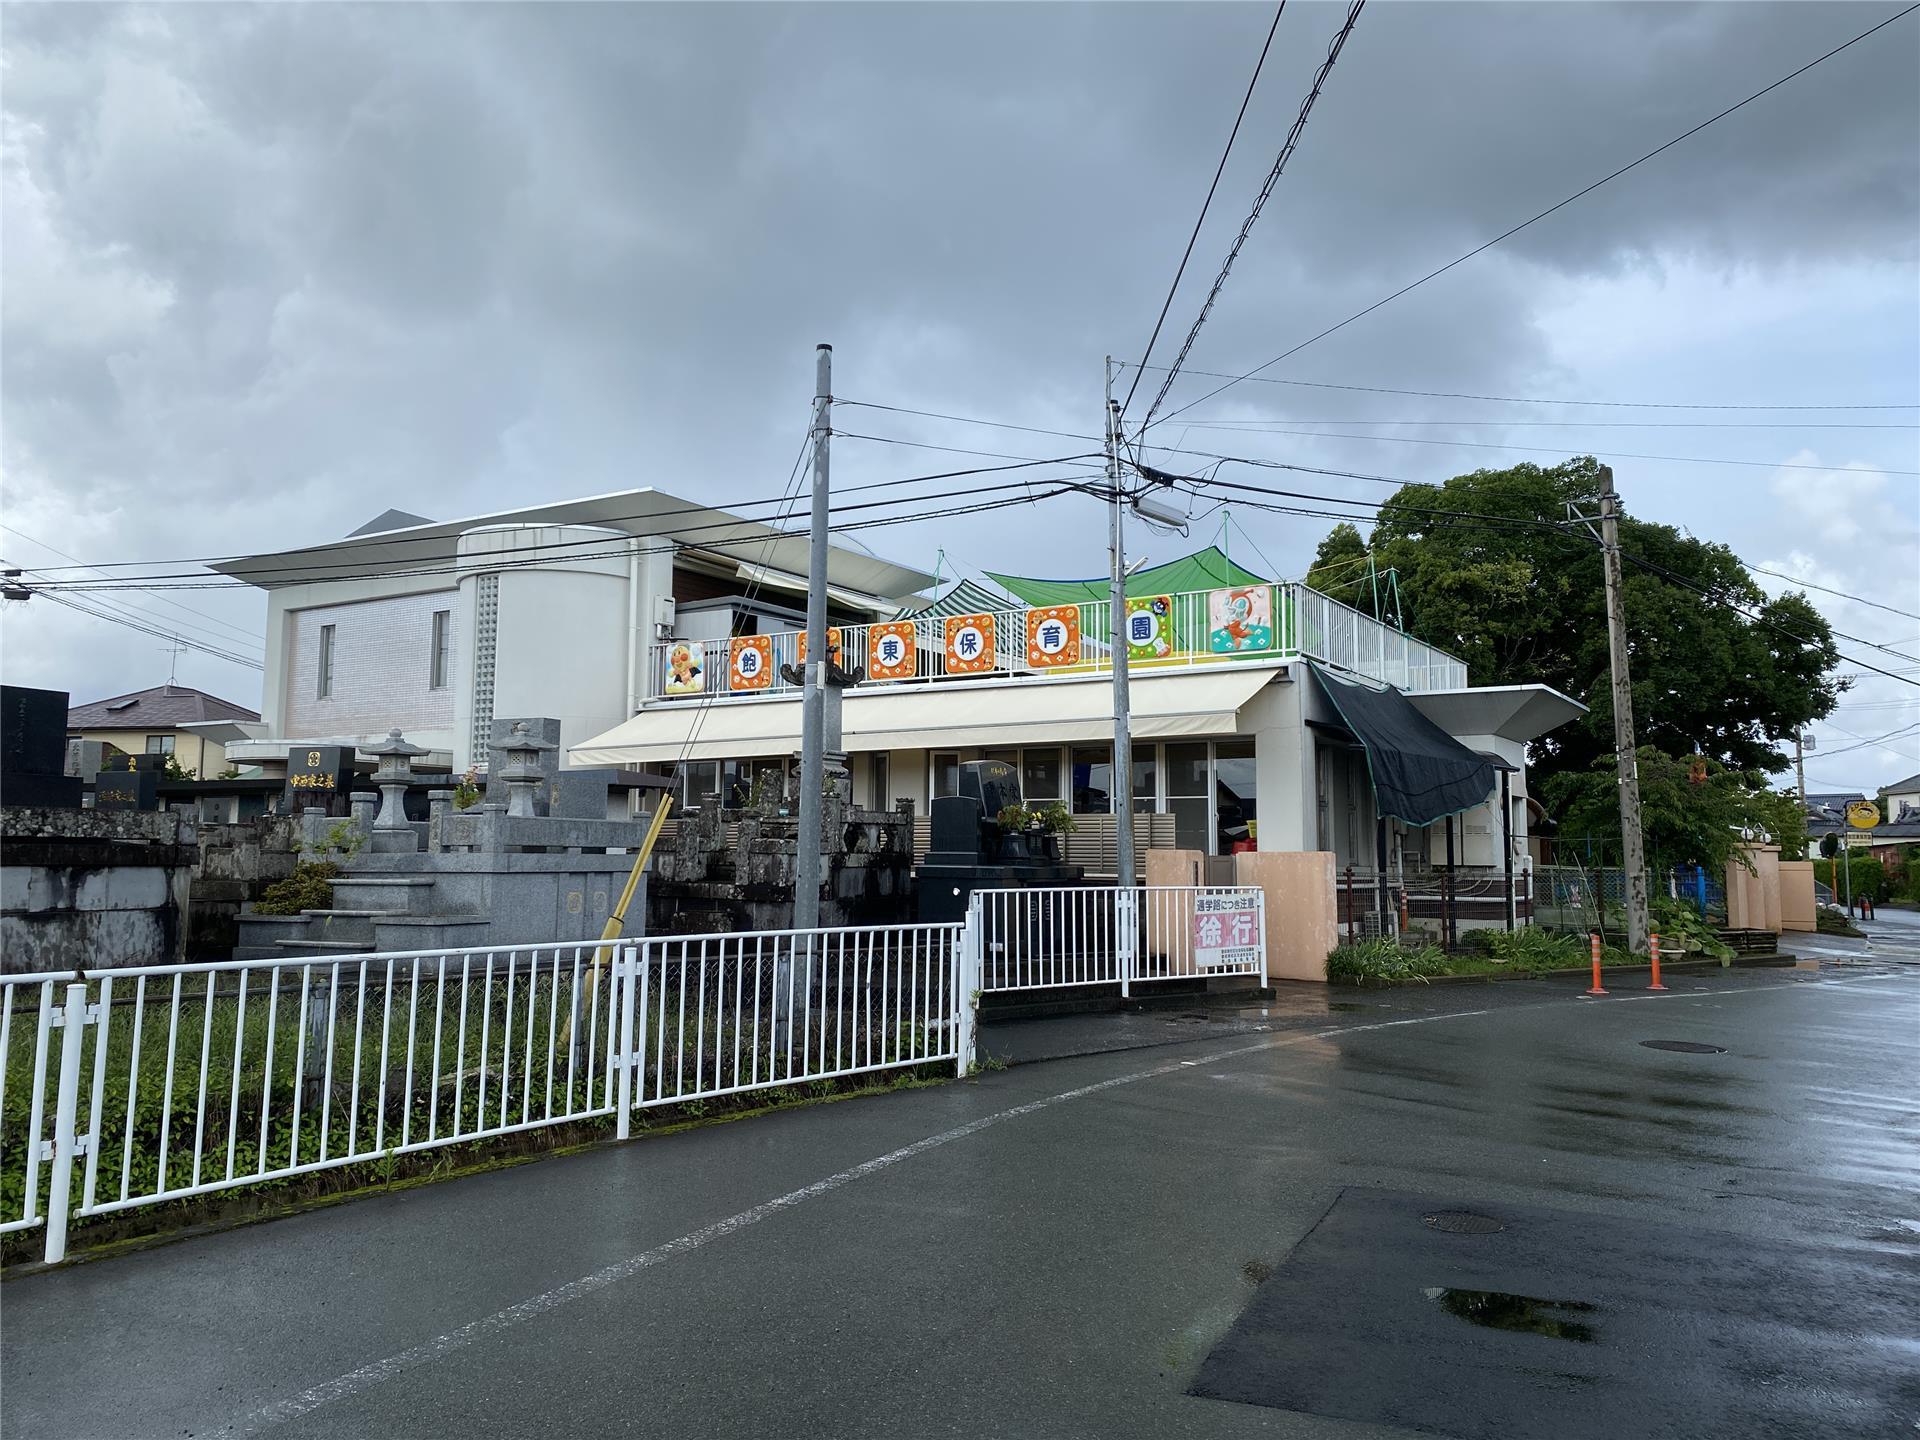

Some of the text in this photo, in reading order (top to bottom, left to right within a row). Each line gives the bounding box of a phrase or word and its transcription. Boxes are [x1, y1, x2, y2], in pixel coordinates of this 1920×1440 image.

[741, 616, 1151, 674] 飽 東 保 育 園
[1196, 898, 1255, 912] 通学路につき注意
[1199, 914, 1252, 946] 徐行
